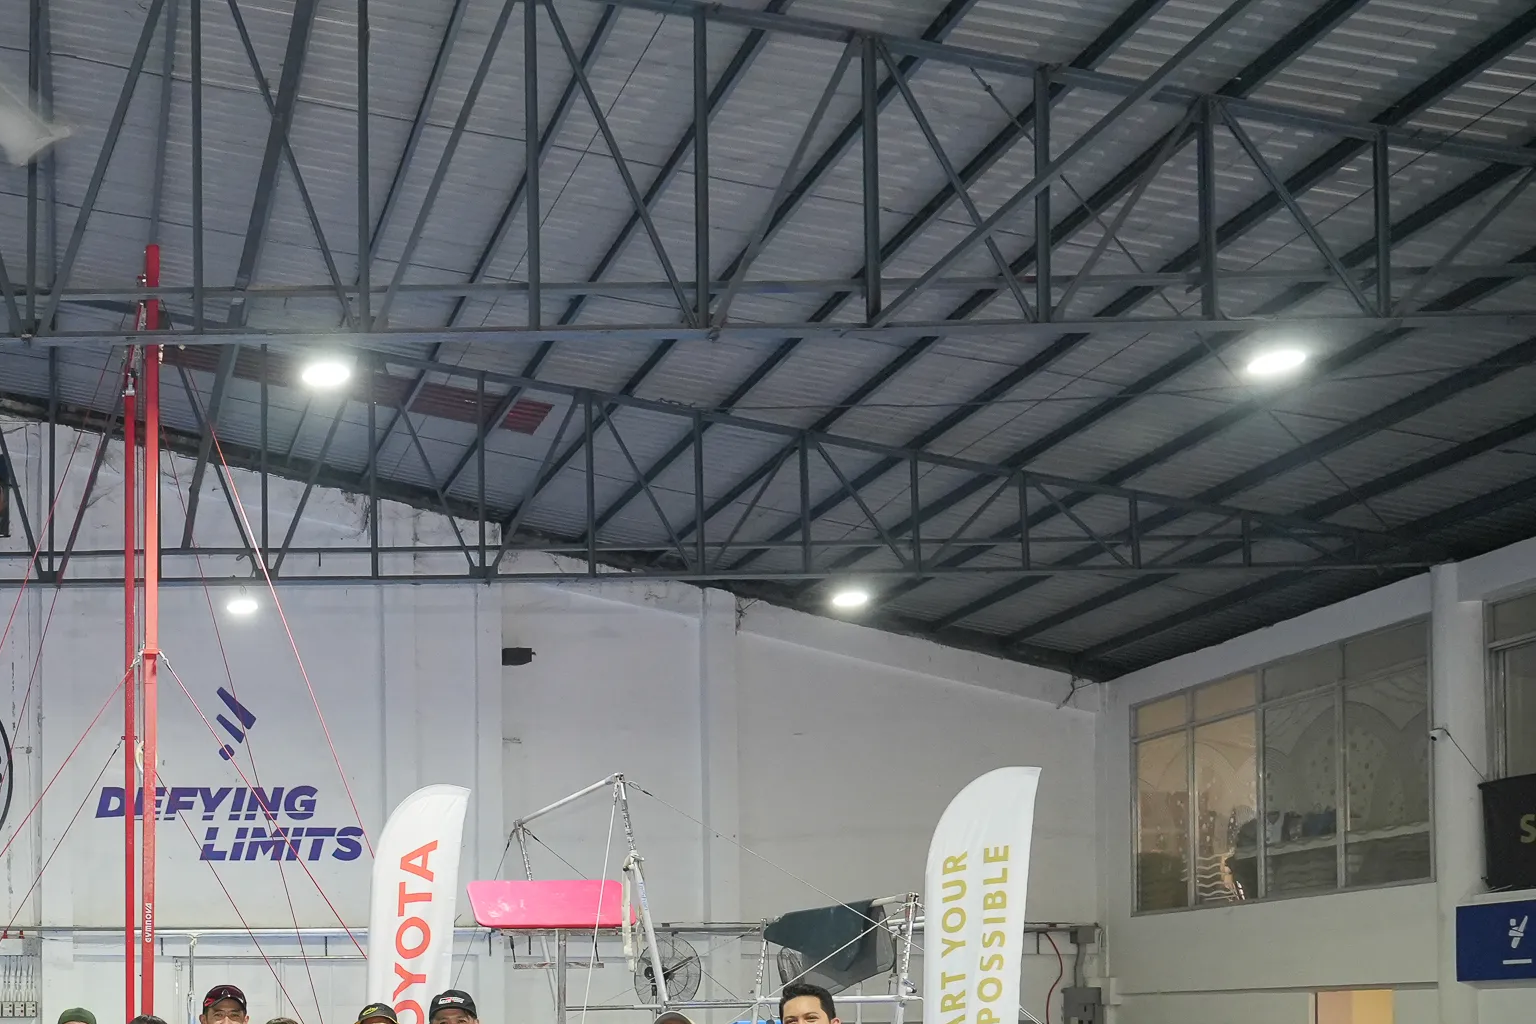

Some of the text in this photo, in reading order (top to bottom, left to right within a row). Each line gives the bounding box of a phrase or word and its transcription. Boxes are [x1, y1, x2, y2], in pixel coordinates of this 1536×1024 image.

[95, 785, 319, 821] DEFYING
[199, 826, 365, 862] LIMITS
[941, 850, 968, 959] YOUR
